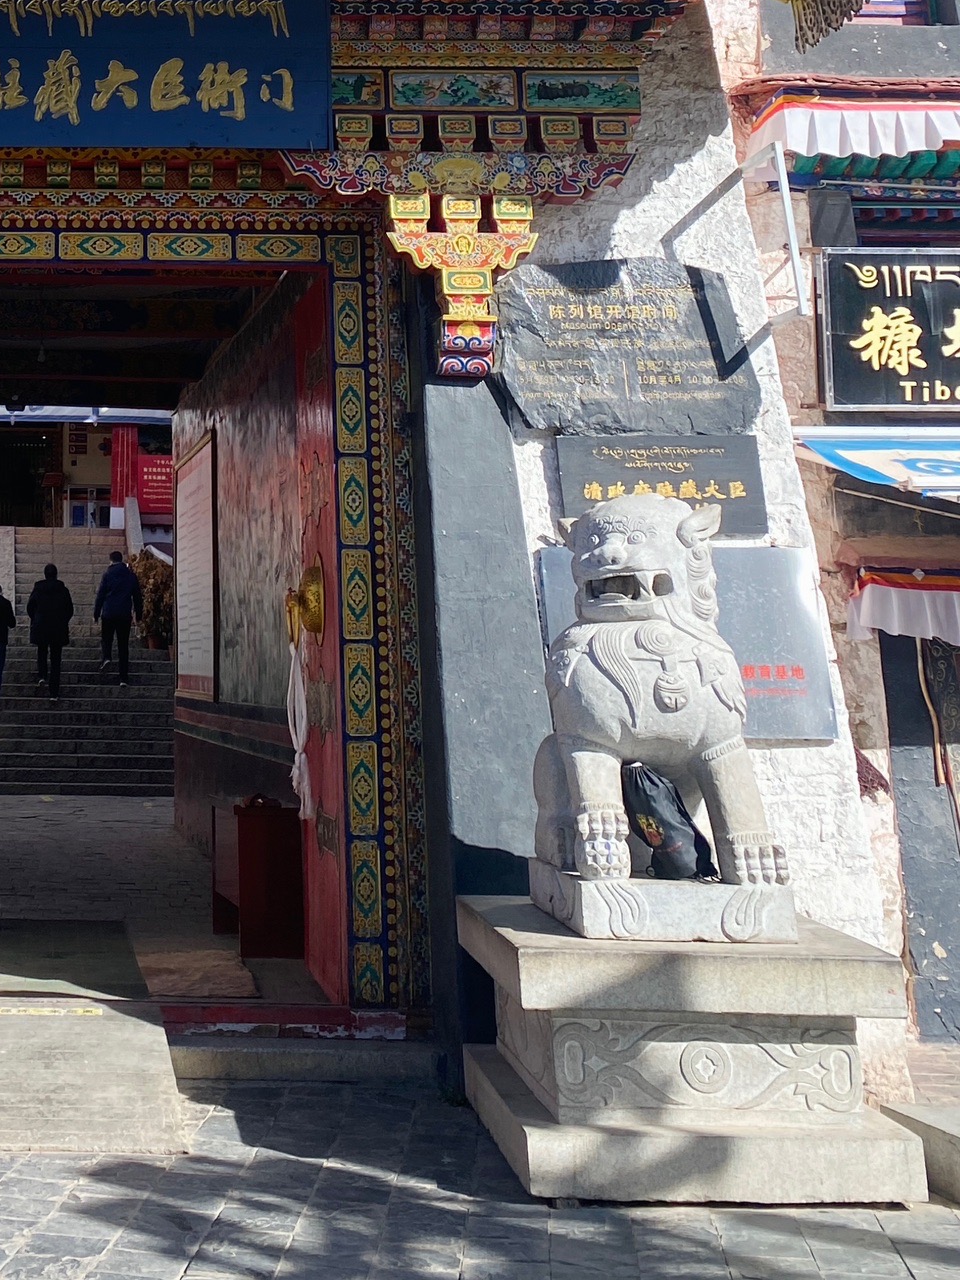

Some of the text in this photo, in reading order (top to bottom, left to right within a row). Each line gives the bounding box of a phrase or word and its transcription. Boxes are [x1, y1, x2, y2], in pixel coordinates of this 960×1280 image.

[548, 304, 678, 320] 陈列馆开馆时间
[742, 664, 805, 680] 教育基地
